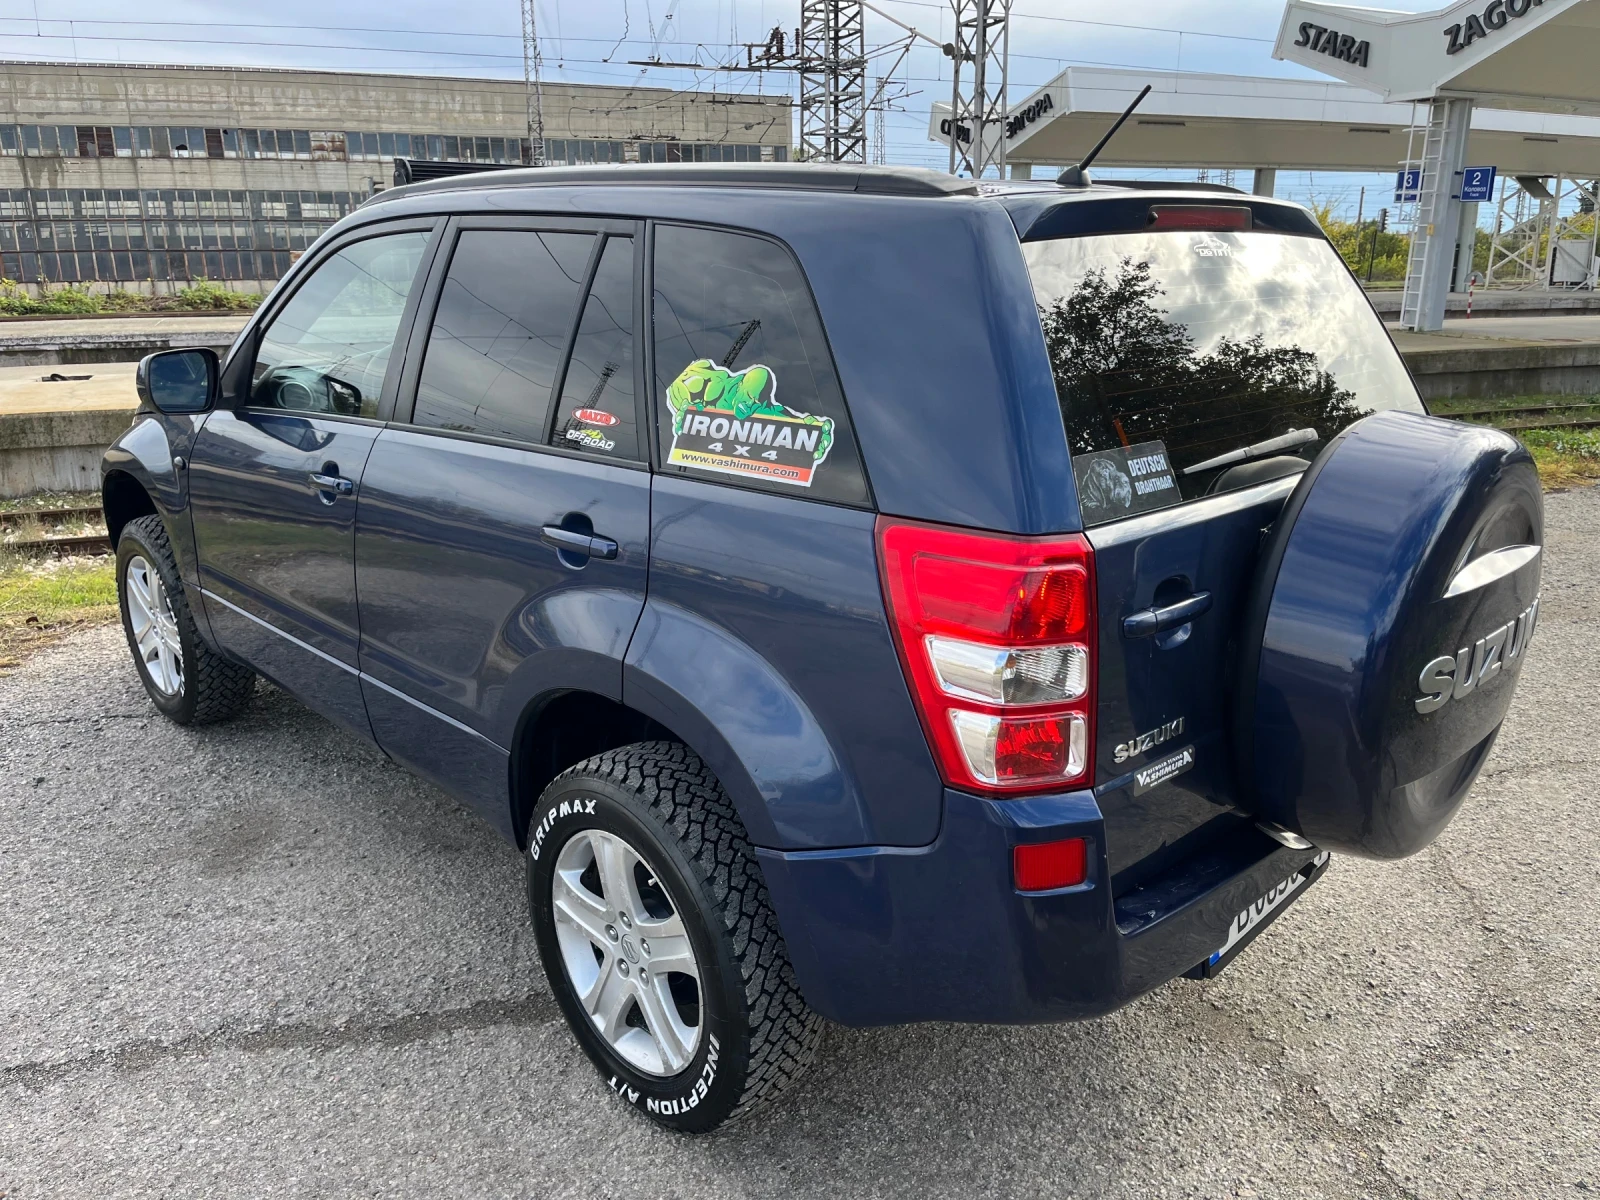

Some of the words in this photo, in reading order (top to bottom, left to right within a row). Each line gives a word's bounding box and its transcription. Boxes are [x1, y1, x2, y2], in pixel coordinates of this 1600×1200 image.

[1294, 21, 1370, 68] STARA
[1405, 174, 1413, 187] 3
[1472, 172, 1481, 185] 2
[580, 409, 612, 425] MAXXIS
[682, 414, 819, 452] IRONMAN
[681, 453, 799, 478] www.vashimura.com
[1127, 453, 1168, 477] DEUTSCH
[1134, 475, 1174, 496] DRAHTHAAR
[1112, 716, 1185, 764] SUZUKI
[1136, 751, 1193, 787] VASHIMURA
[531, 799, 597, 861] GRIPMAX
[646, 1033, 720, 1115] INCEPTION
[607, 1076, 640, 1104] A/T
